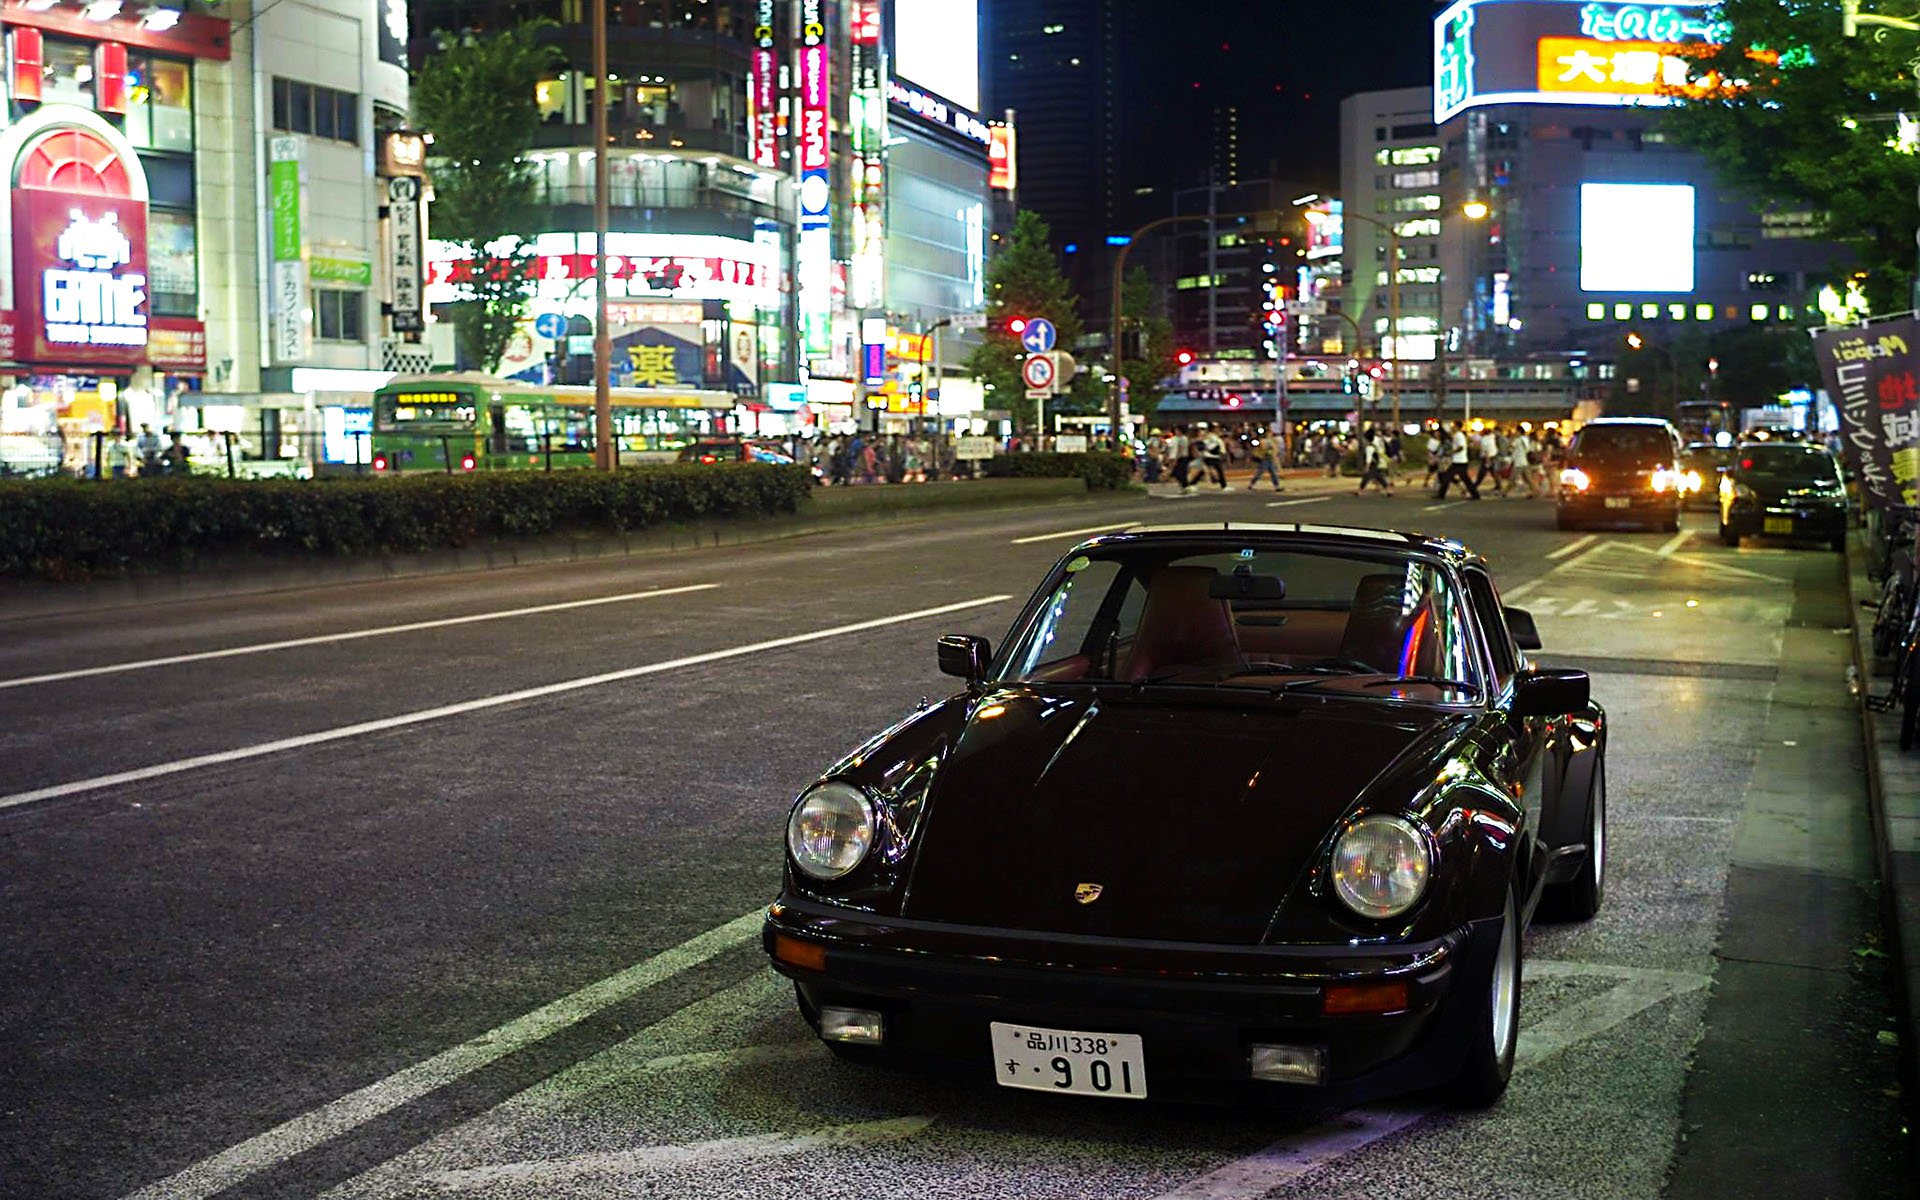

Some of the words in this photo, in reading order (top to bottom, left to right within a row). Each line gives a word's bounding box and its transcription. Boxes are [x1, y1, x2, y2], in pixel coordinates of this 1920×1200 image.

[44, 268, 147, 326] GAME
[627, 344, 677, 386] 薬
[1005, 1058, 1021, 1075] す
